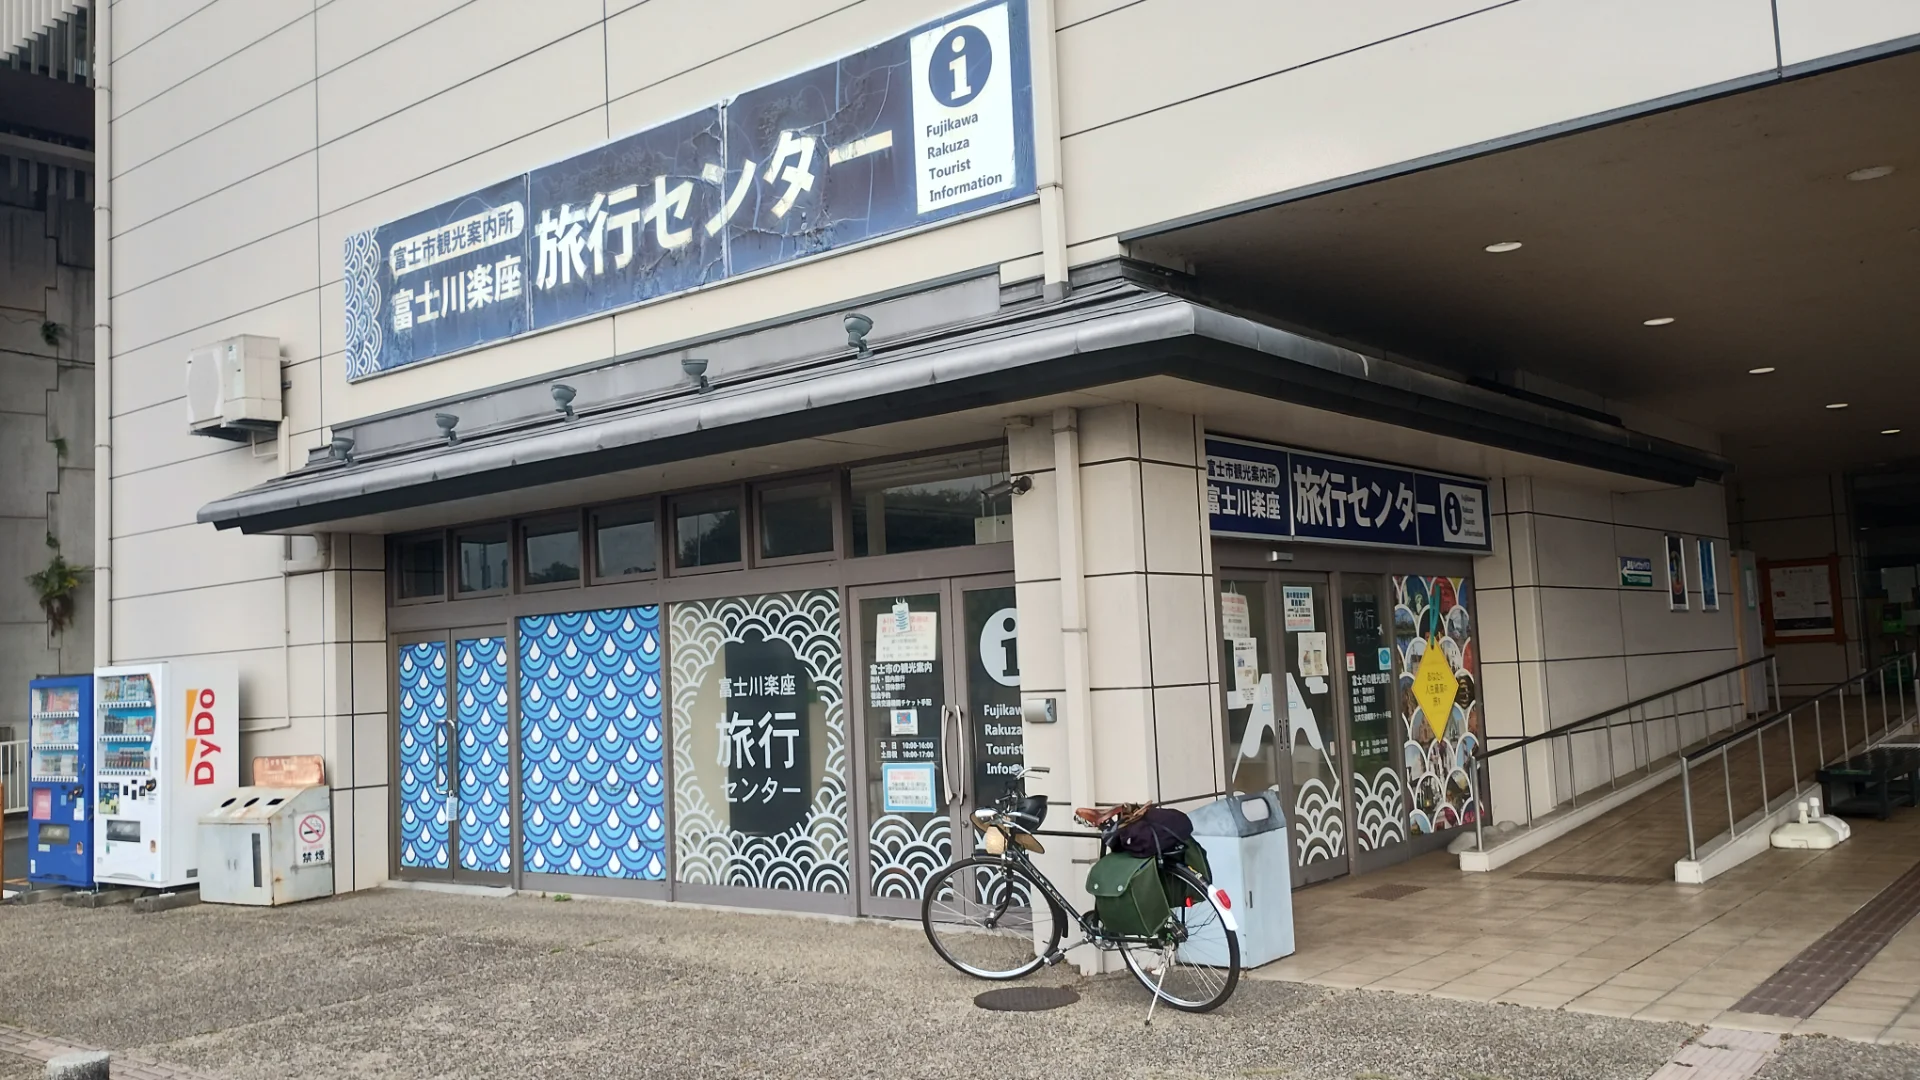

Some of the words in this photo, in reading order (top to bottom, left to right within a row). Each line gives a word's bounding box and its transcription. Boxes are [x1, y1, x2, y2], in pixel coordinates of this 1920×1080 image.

[926, 112, 978, 138] Fujikawa
[927, 138, 970, 159] Rakuza
[929, 158, 971, 180] Tourist
[929, 173, 1002, 202] Information
[535, 130, 893, 290] 旅行センター
[394, 208, 514, 271] 富士市観光案内所
[391, 254, 521, 332] 富士川楽座
[1207, 459, 1277, 485] 富士市観光案内所
[1208, 484, 1281, 519] 富士川楽座
[1293, 464, 1436, 532] 旅行センター
[870, 661, 933, 675] 富士市の観光案内
[718, 673, 796, 699] 富士川楽座
[983, 703, 1022, 719] Fujikaw
[194, 688, 221, 786] DyDo
[716, 711, 800, 769] 旅行
[984, 723, 1023, 736] Rakuza
[985, 743, 1024, 755] Tourist
[720, 776, 801, 804] センター
[302, 849, 325, 864] 禁煙
